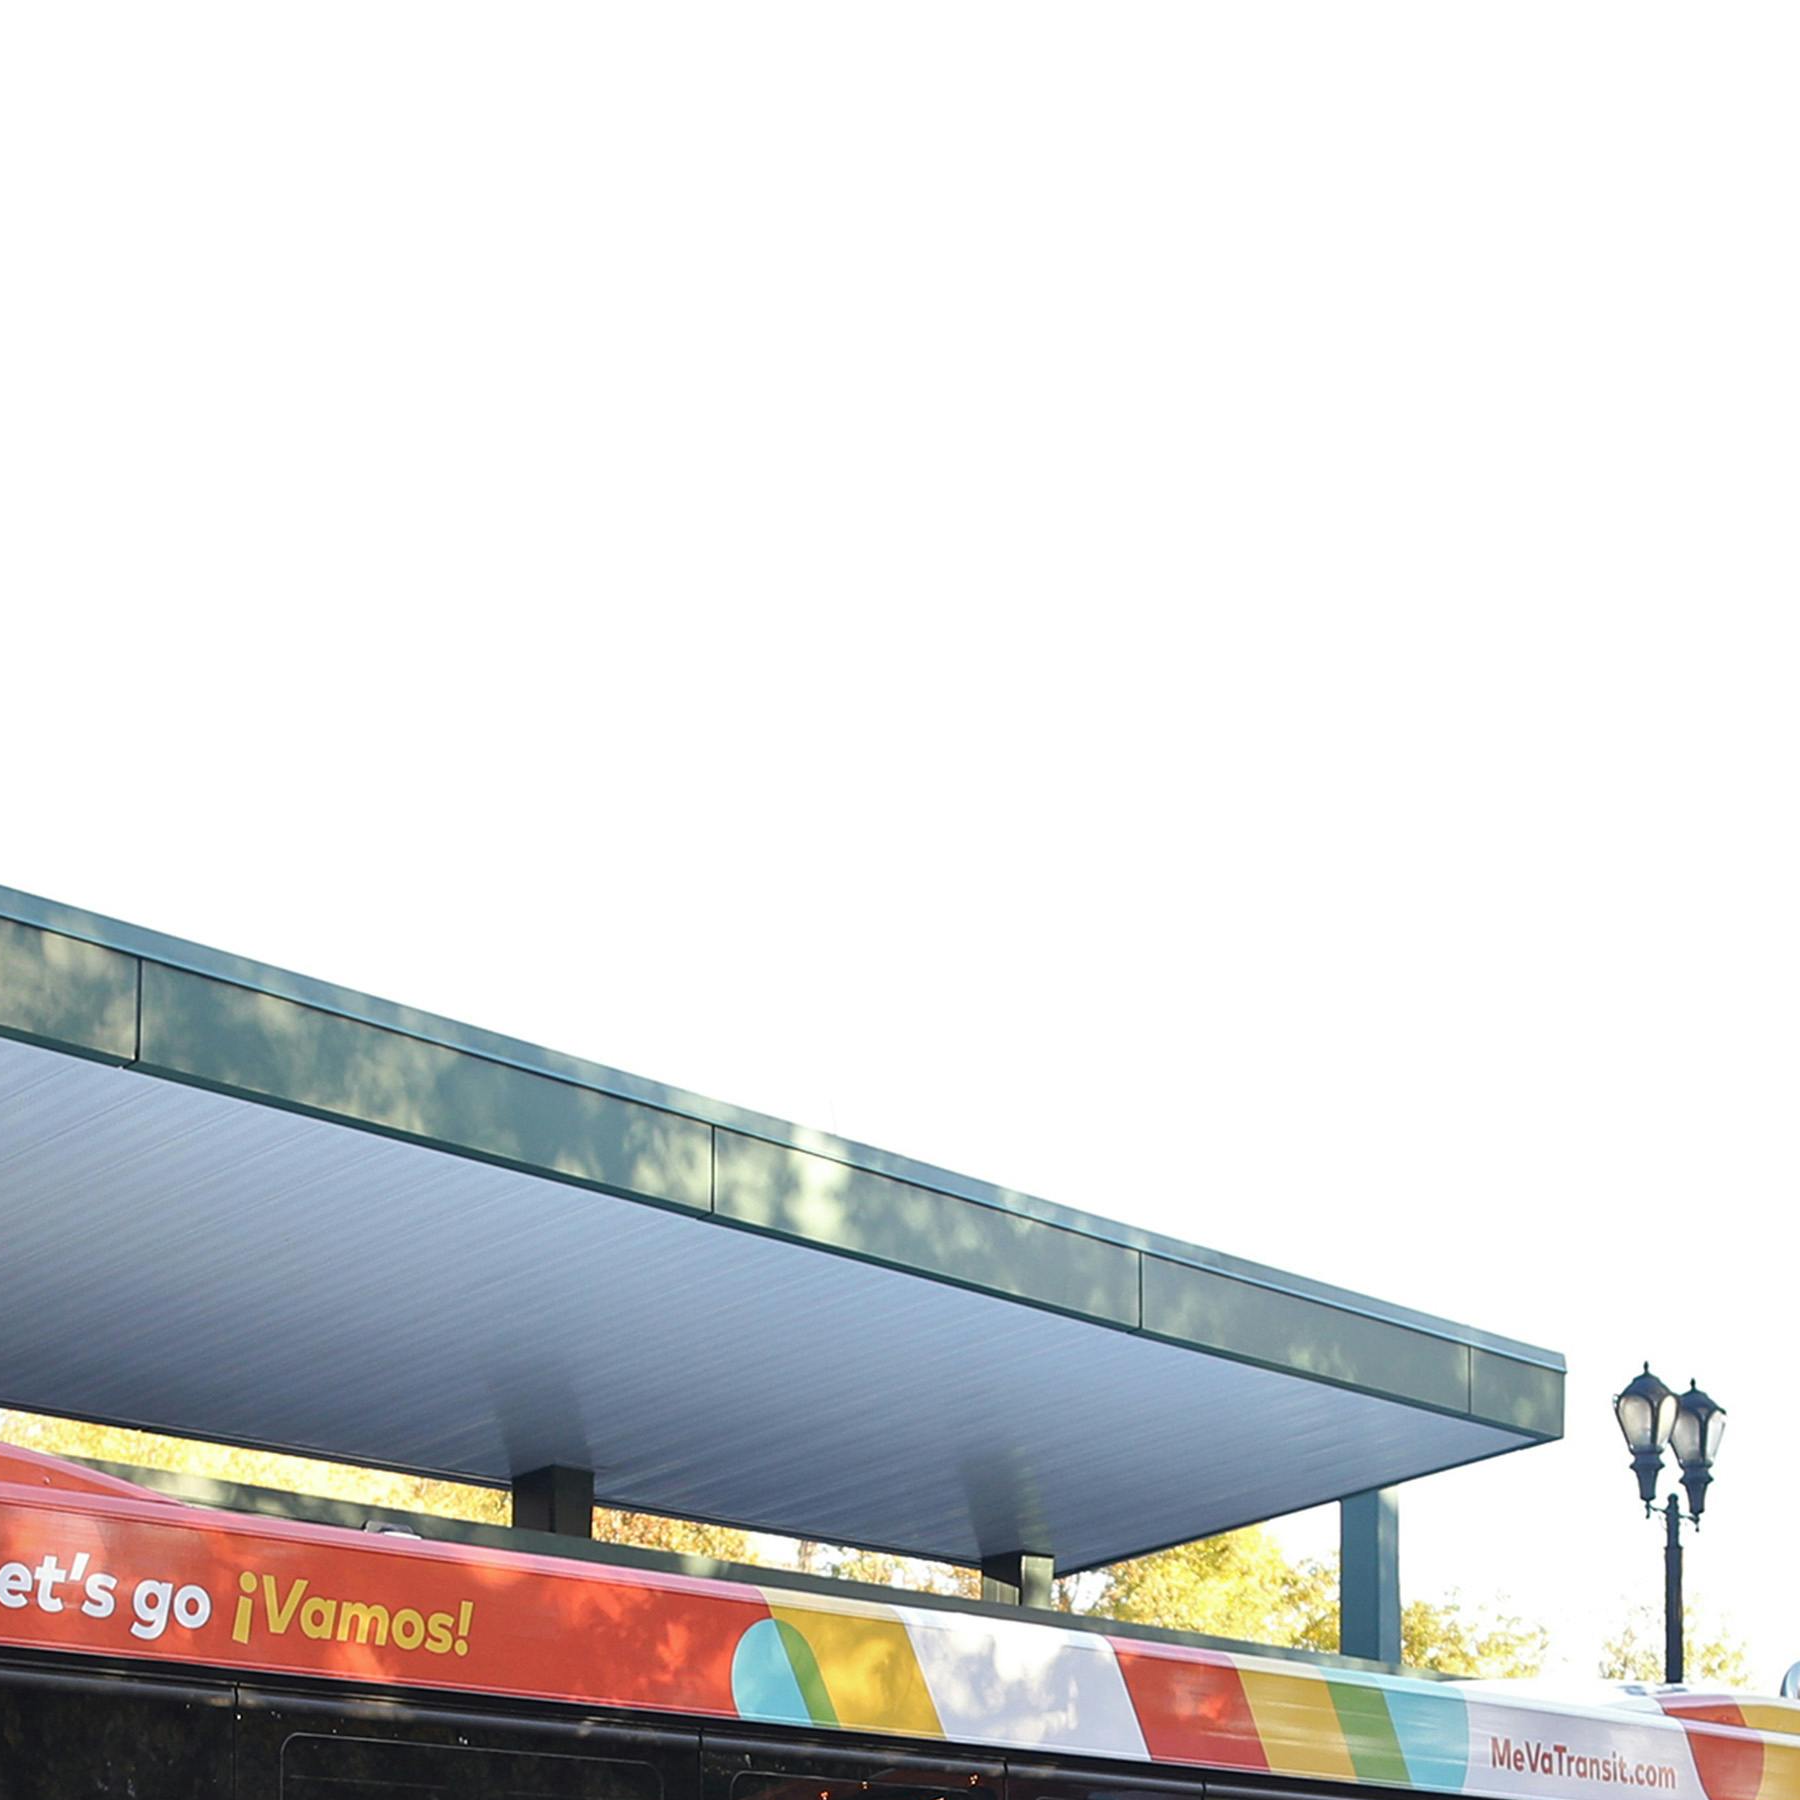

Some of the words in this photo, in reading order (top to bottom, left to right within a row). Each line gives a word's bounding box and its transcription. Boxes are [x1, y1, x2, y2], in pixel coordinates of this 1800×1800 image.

[131, 1578, 212, 1641] go
[231, 1571, 474, 1657] ¡Vamos!
[1490, 1736, 1676, 1789] MeVaTransit.com
